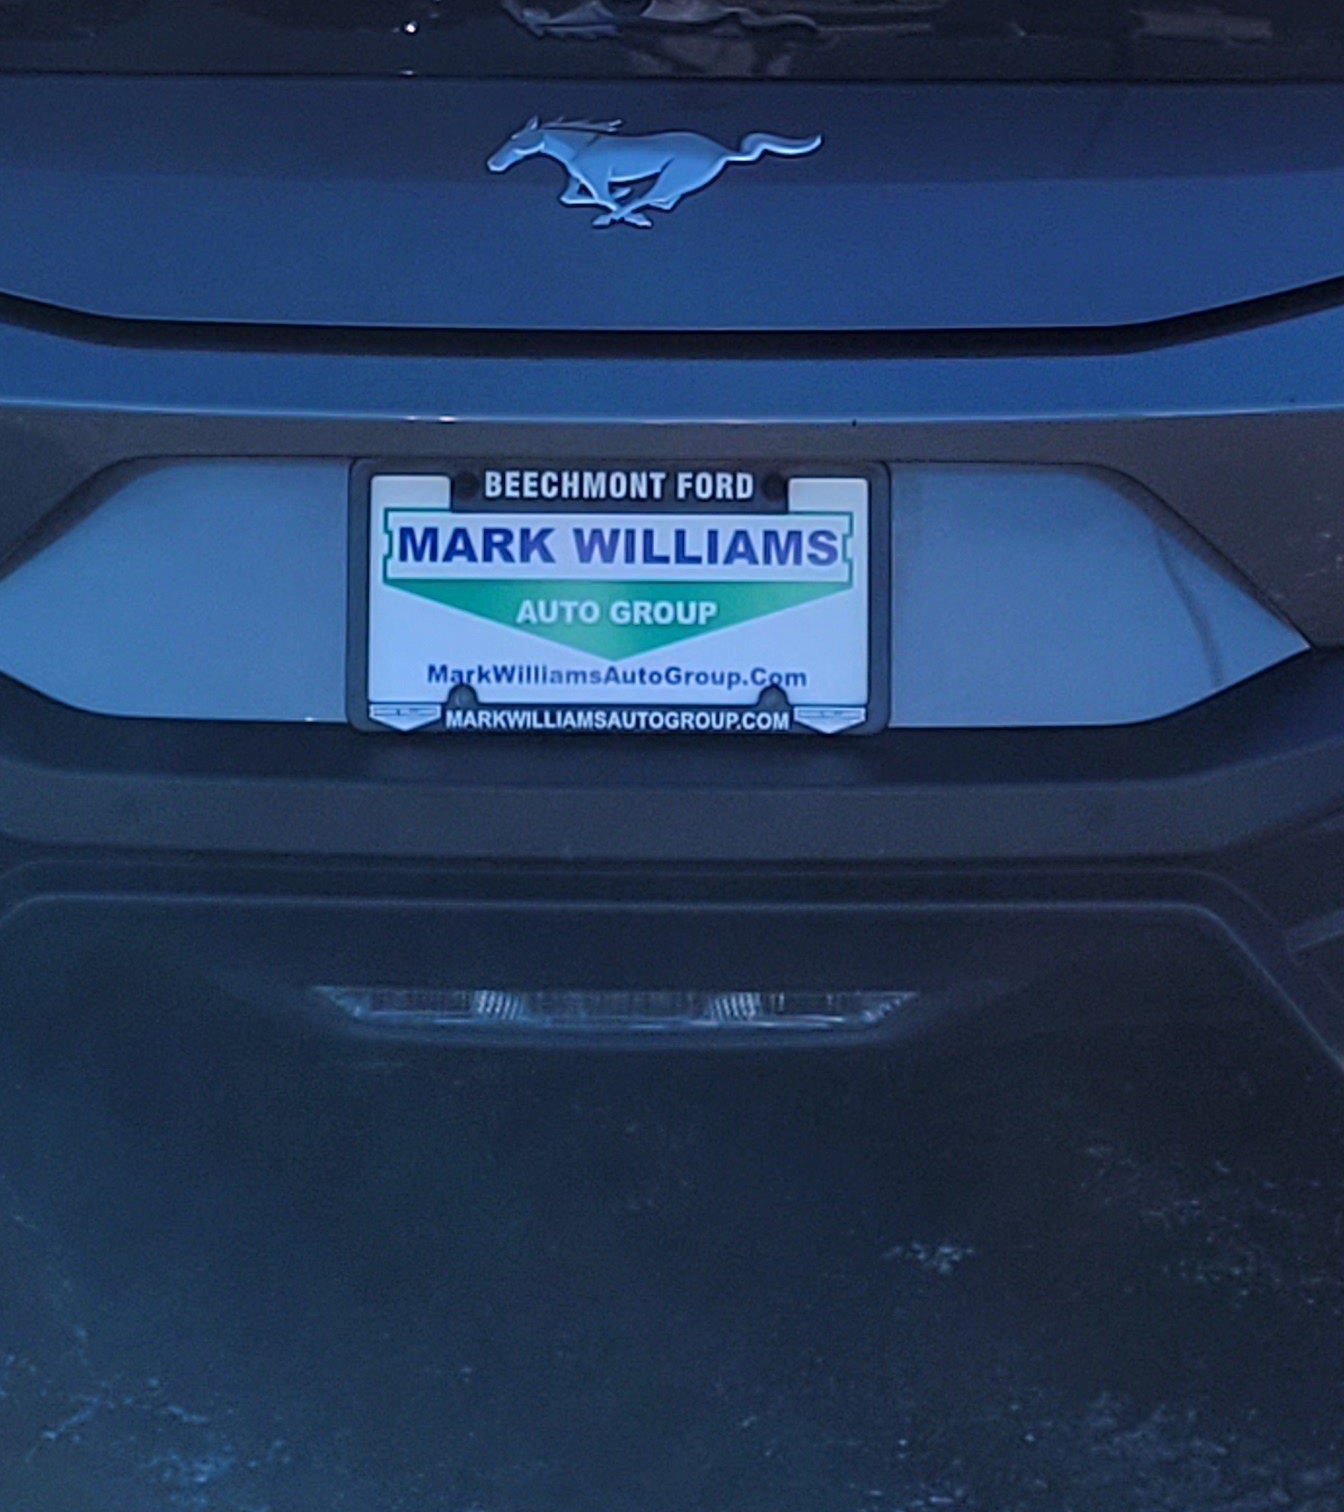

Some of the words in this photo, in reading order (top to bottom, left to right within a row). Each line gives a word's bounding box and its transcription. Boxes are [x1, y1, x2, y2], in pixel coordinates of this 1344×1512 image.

[484, 470, 666, 500] BEECHMONT
[676, 472, 754, 500] FORD
[398, 526, 556, 564] MARK
[572, 527, 839, 567] WILLIAMS
[516, 599, 601, 625] AUTO
[610, 600, 718, 626] GROUP
[427, 663, 808, 691] MarkWilliamsAutoGroup.Com
[445, 709, 790, 731] MARKWILLIAMSAUTOGROUP.COM
